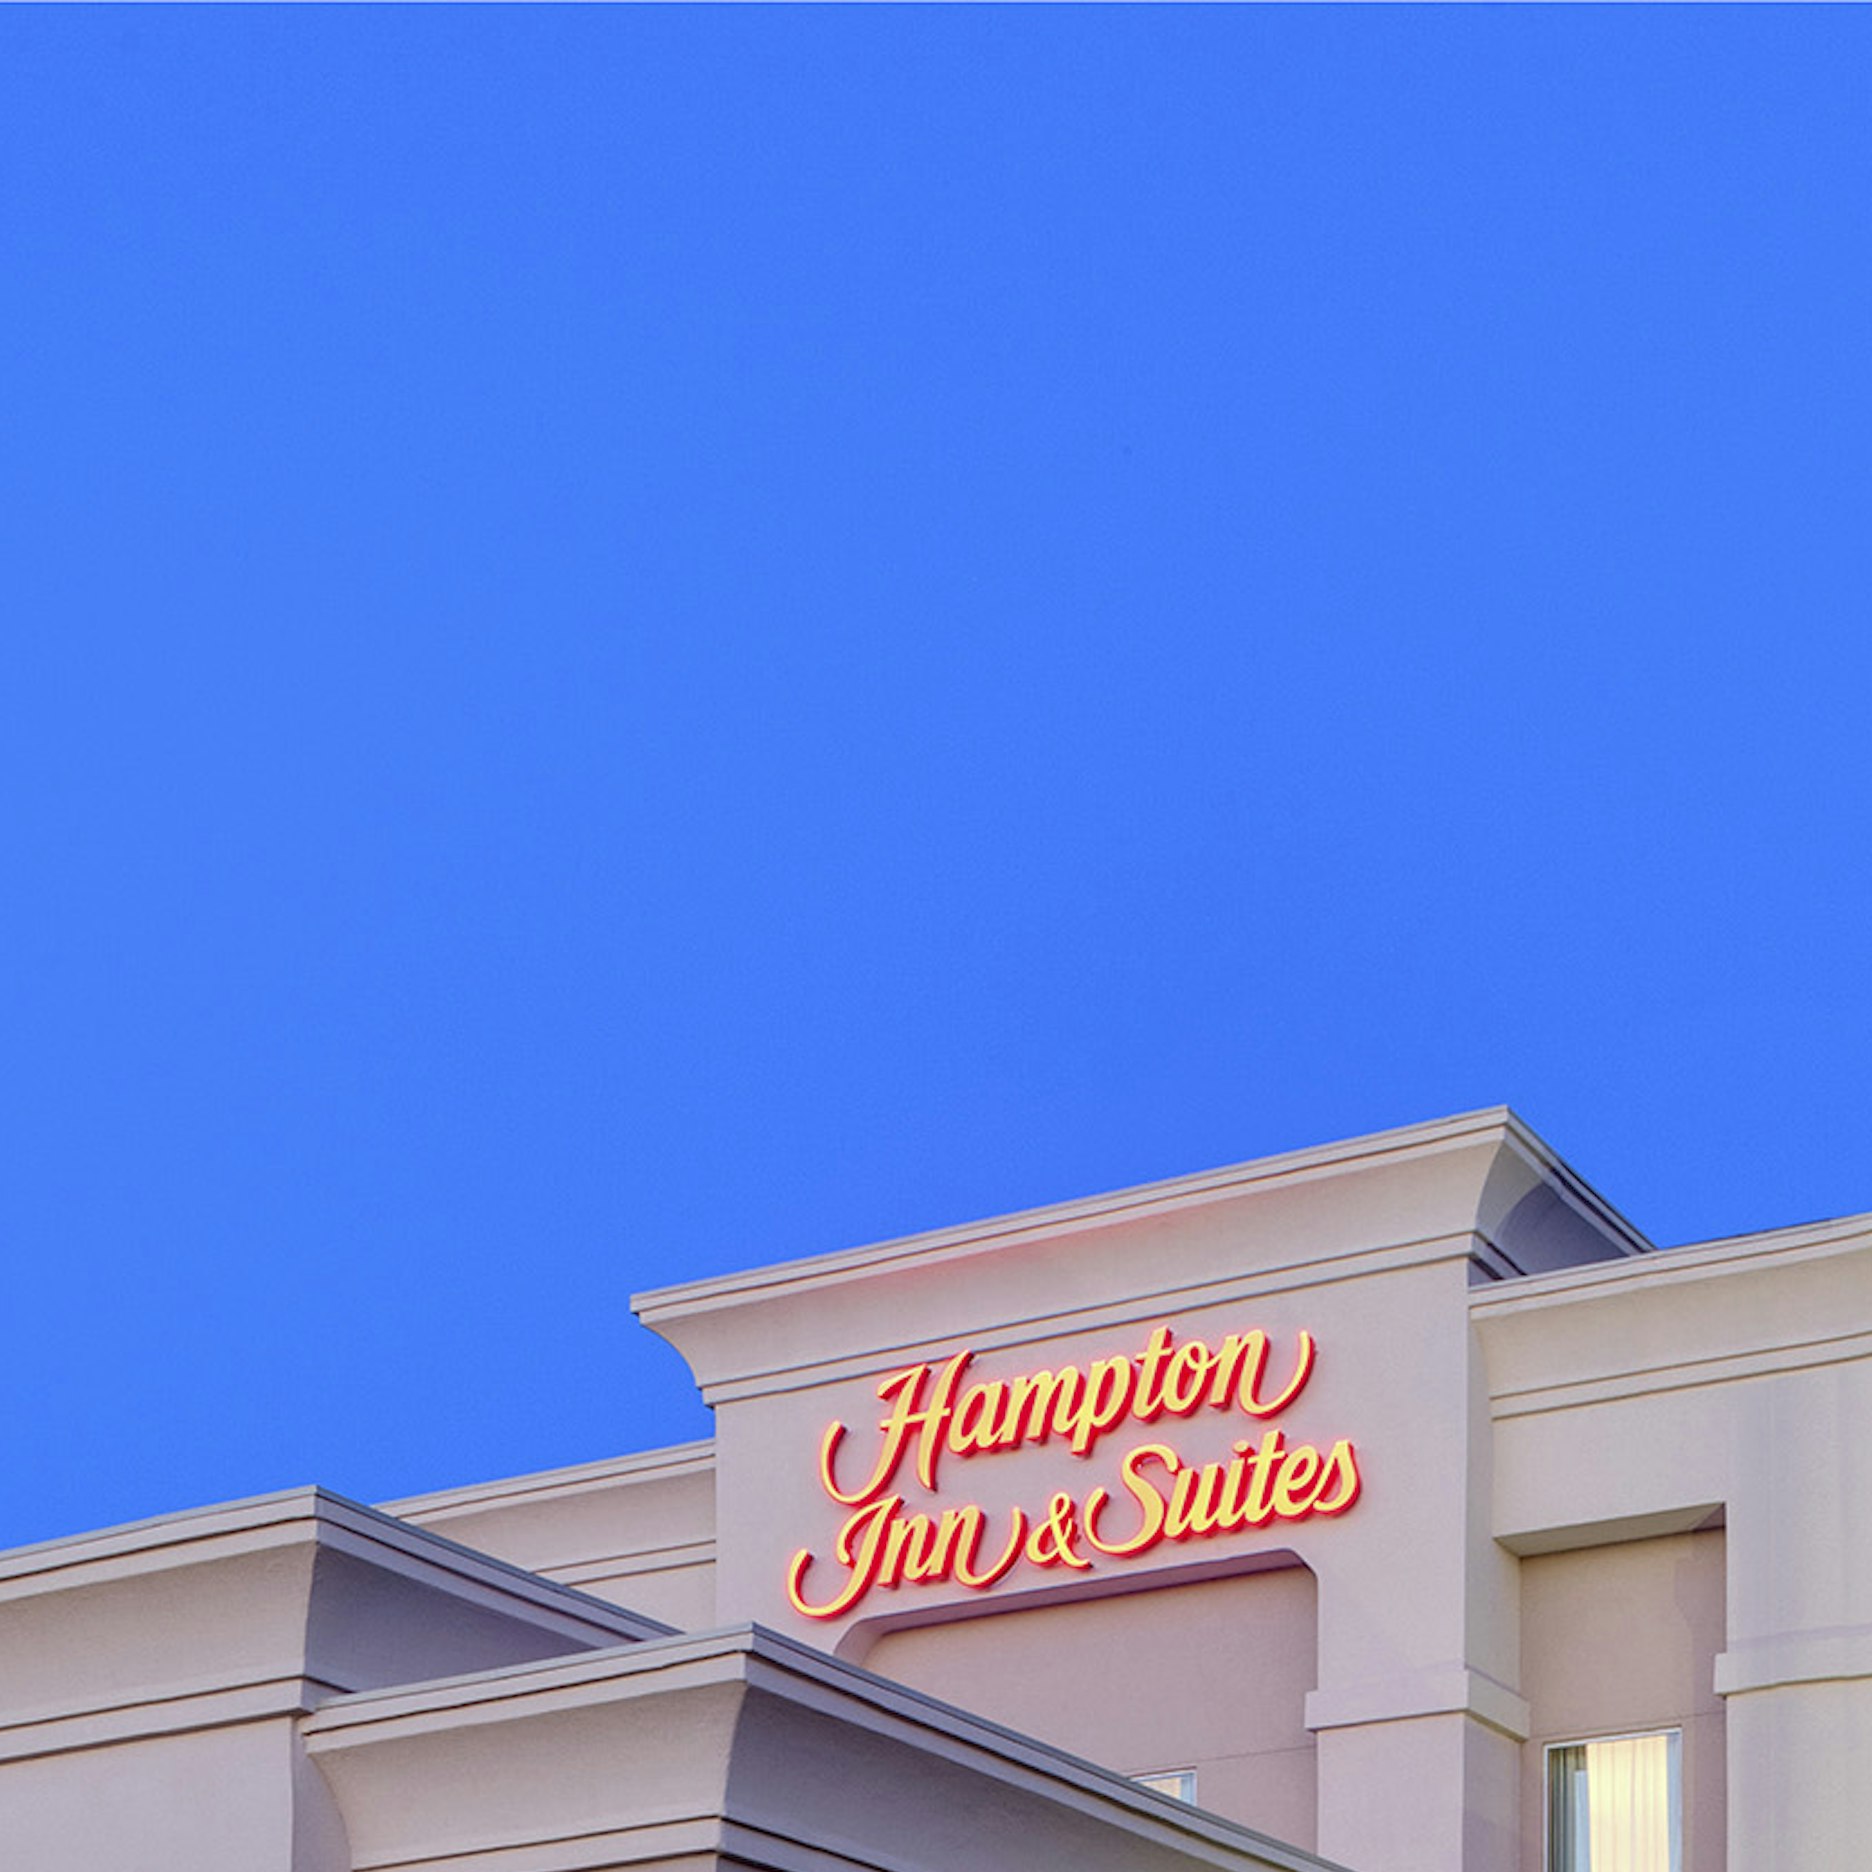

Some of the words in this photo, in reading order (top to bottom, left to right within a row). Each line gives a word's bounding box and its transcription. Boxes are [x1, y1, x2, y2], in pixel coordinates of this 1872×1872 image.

[820, 1326, 1315, 1506] Hampton
[786, 1494, 1028, 1619] Inn
[1025, 1492, 1093, 1572] &
[1083, 1428, 1362, 1556] Suites
